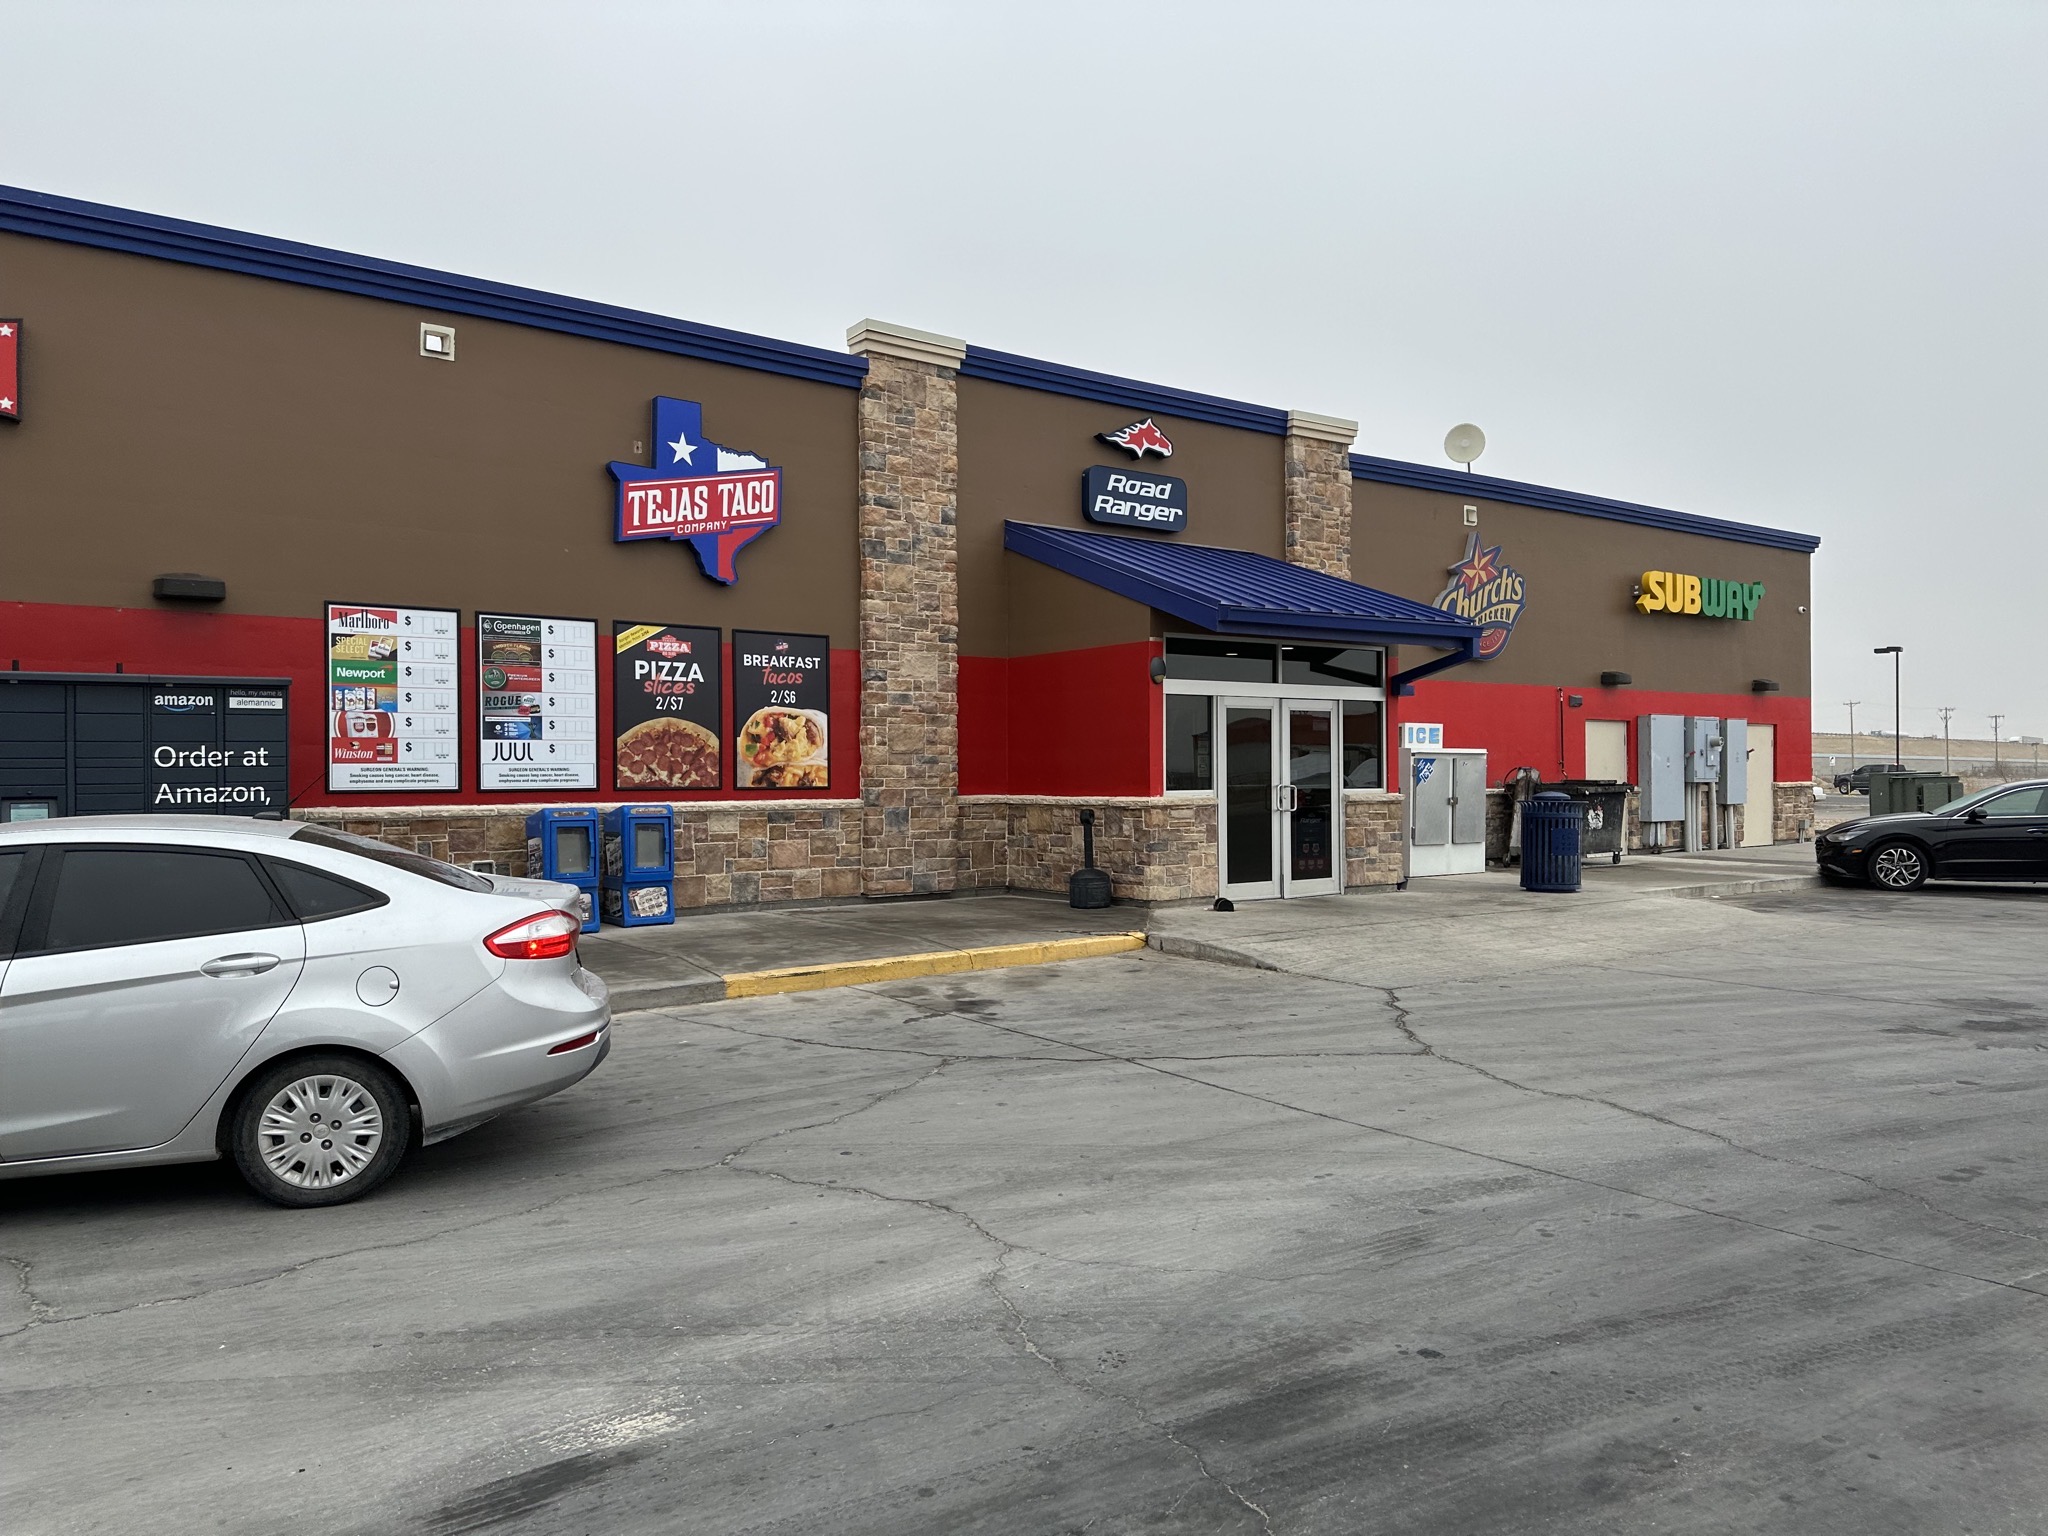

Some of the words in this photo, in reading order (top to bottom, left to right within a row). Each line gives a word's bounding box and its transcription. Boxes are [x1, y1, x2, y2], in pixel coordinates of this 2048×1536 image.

[1107, 474, 1172, 499] Road
[628, 485, 709, 526] TEJAS
[717, 479, 775, 518] TACO
[1094, 495, 1183, 522] Ranger
[677, 520, 728, 534] COMPANY
[1441, 568, 1523, 618] Church's
[1635, 570, 1766, 621] SUBWAY
[338, 609, 390, 630] Marlboro
[1474, 607, 1512, 625] HICKEN
[493, 620, 540, 635] Copenhagen
[335, 636, 368, 646] SPECIAL
[335, 645, 365, 654] SELECT
[649, 641, 690, 653] PIZZA
[634, 659, 705, 683] PIZZA
[743, 654, 821, 670] BREAKFAST
[336, 667, 386, 680] Newport
[762, 665, 803, 686] tacos
[230, 689, 247, 698] hello,
[248, 690, 259, 698] my
[643, 673, 696, 696] slices
[154, 695, 214, 706] amazon
[236, 699, 276, 707] alemannic
[485, 695, 522, 706] ROGUE
[655, 696, 684, 711] 2/$7
[770, 689, 796, 704] 2/$6
[1408, 726, 1440, 744] ICE
[154, 745, 234, 768] Order
[242, 747, 269, 767] at
[334, 747, 374, 759] Winston
[491, 742, 534, 761] JUUL
[1420, 764, 1434, 783] ICE
[154, 783, 271, 806] Amazon,
